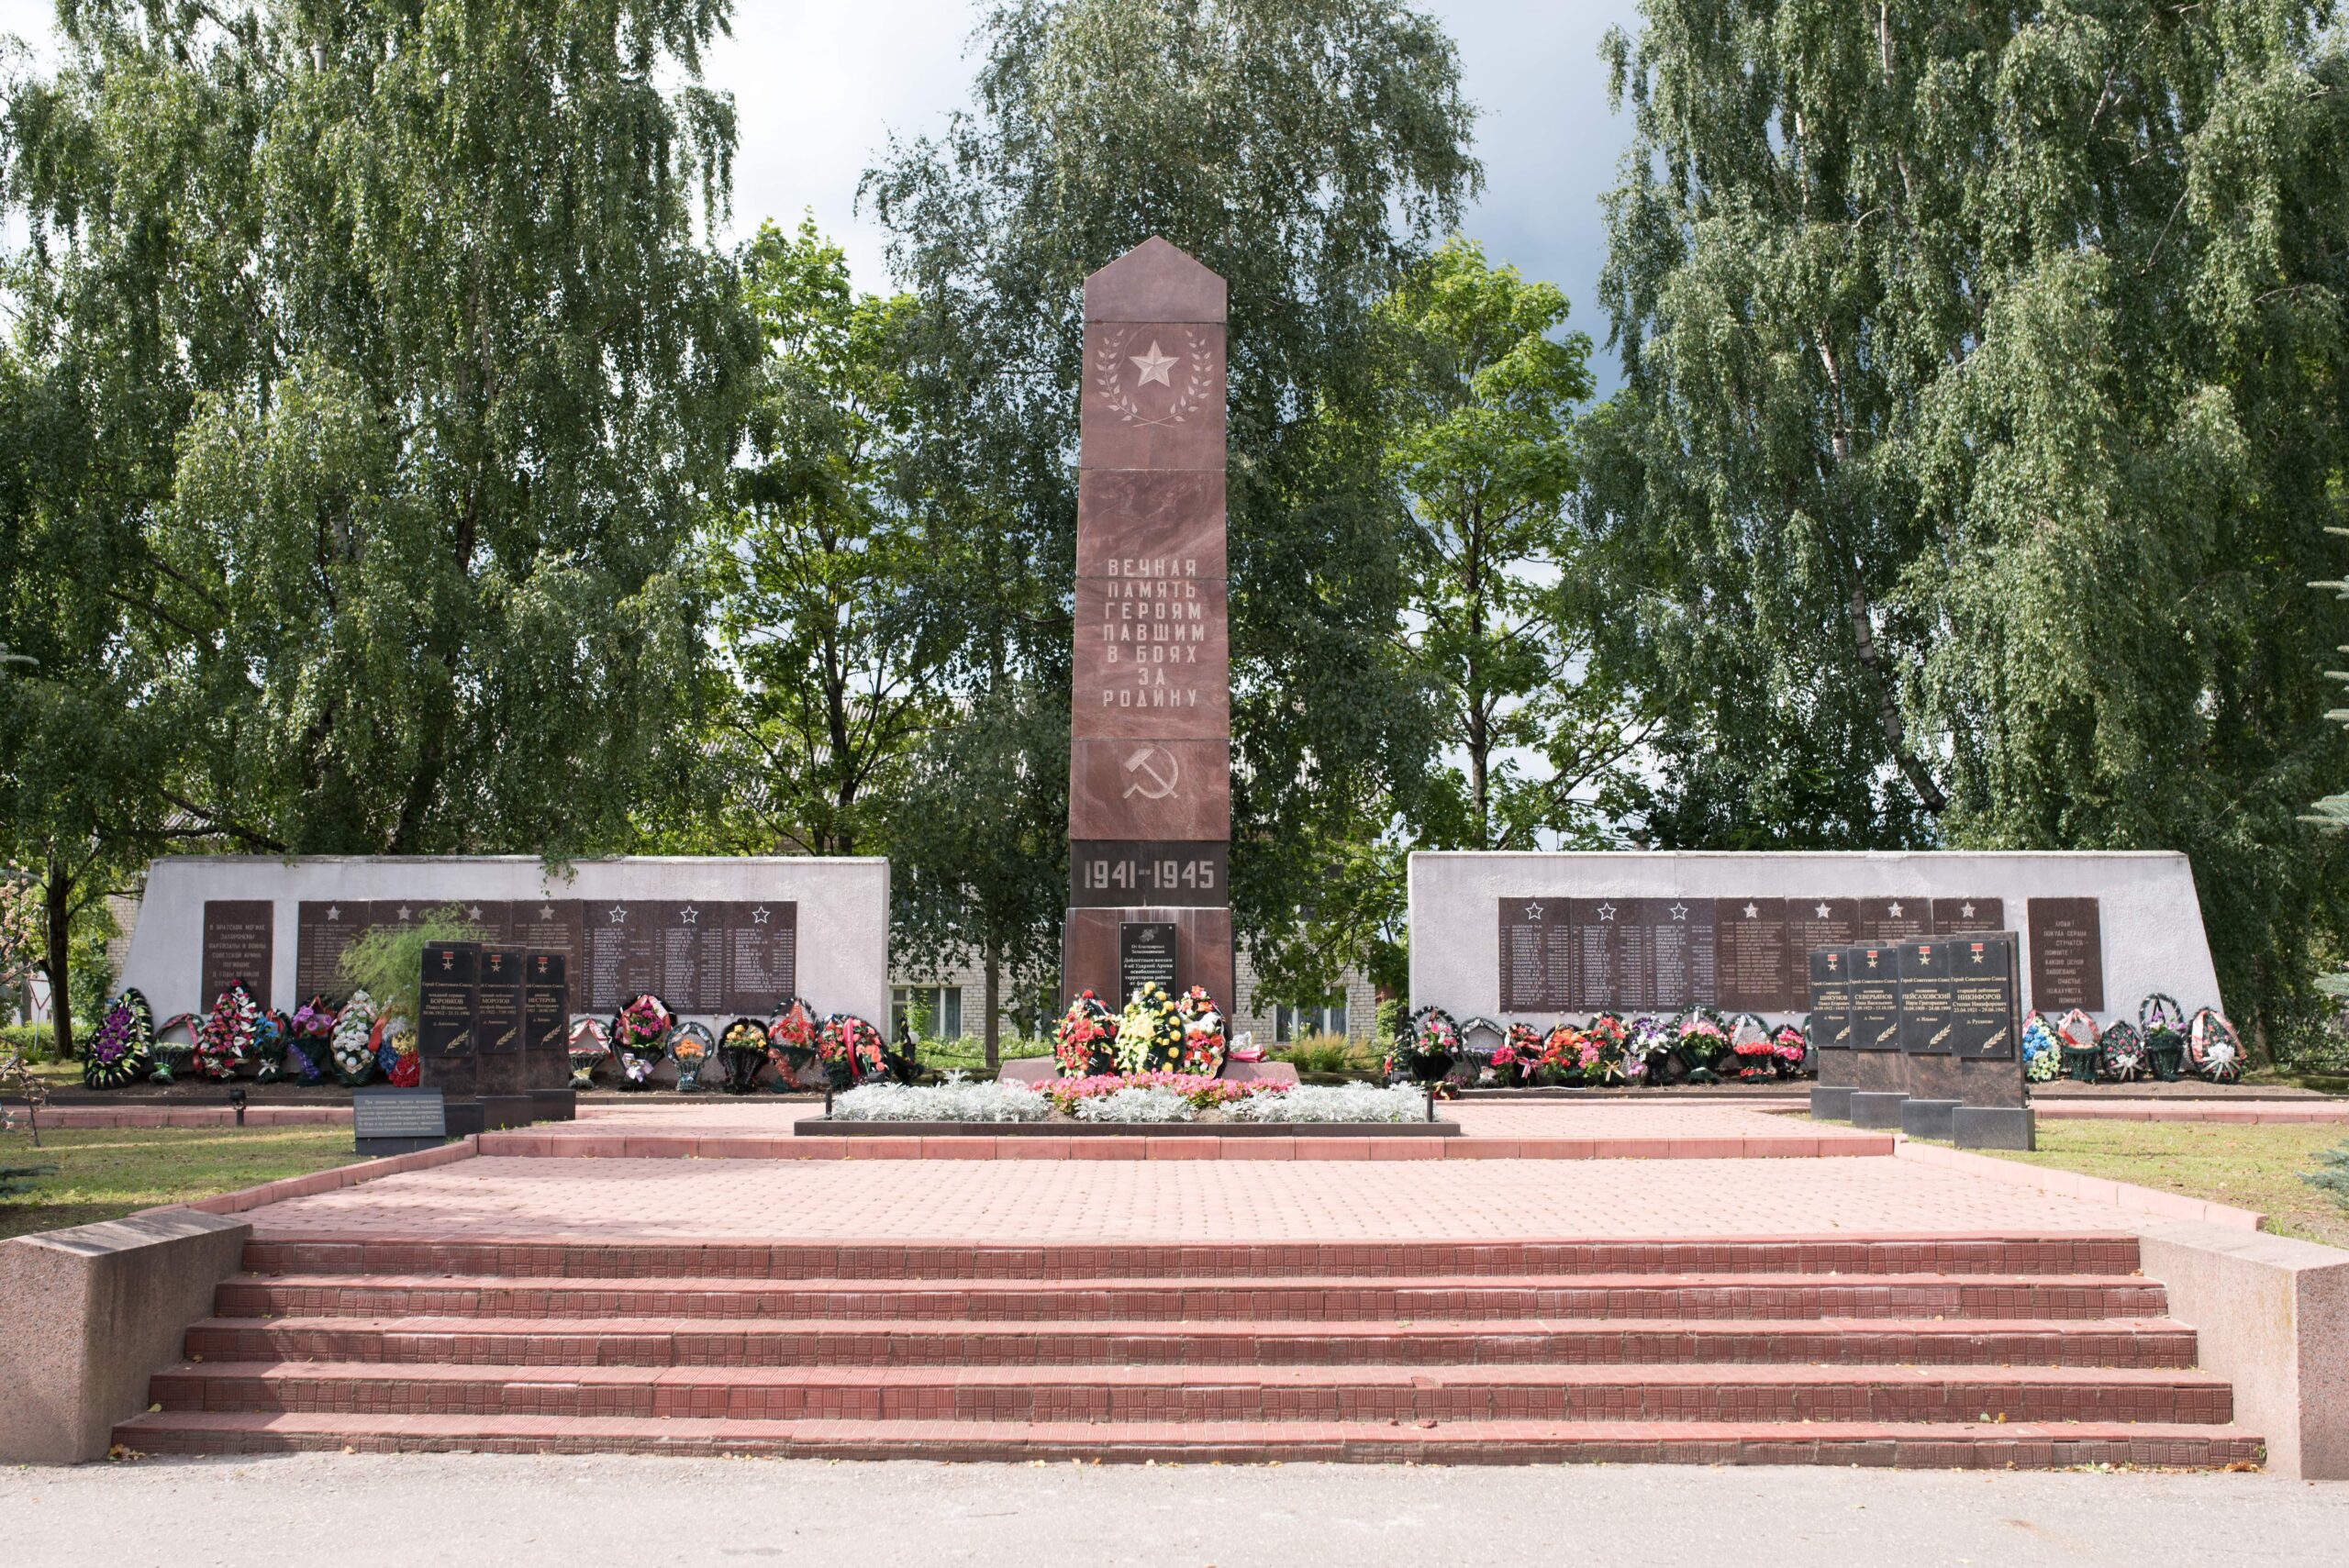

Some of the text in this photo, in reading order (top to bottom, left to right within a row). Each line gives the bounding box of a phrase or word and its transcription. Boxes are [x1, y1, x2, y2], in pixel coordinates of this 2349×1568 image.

[1108, 559, 1197, 576] ВЕЧНАЯ
[1108, 581, 1196, 597] ПАМЯТЬ
[1105, 602, 1201, 619] ГЕРОЯМ
[1103, 624, 1205, 641] ПАВШИМ
[1108, 645, 1197, 662] В БОЯХ
[1138, 668, 1165, 684] ЗА
[1103, 689, 1197, 707] РОДИНУ
[1085, 860, 1214, 888] 1941-1945
